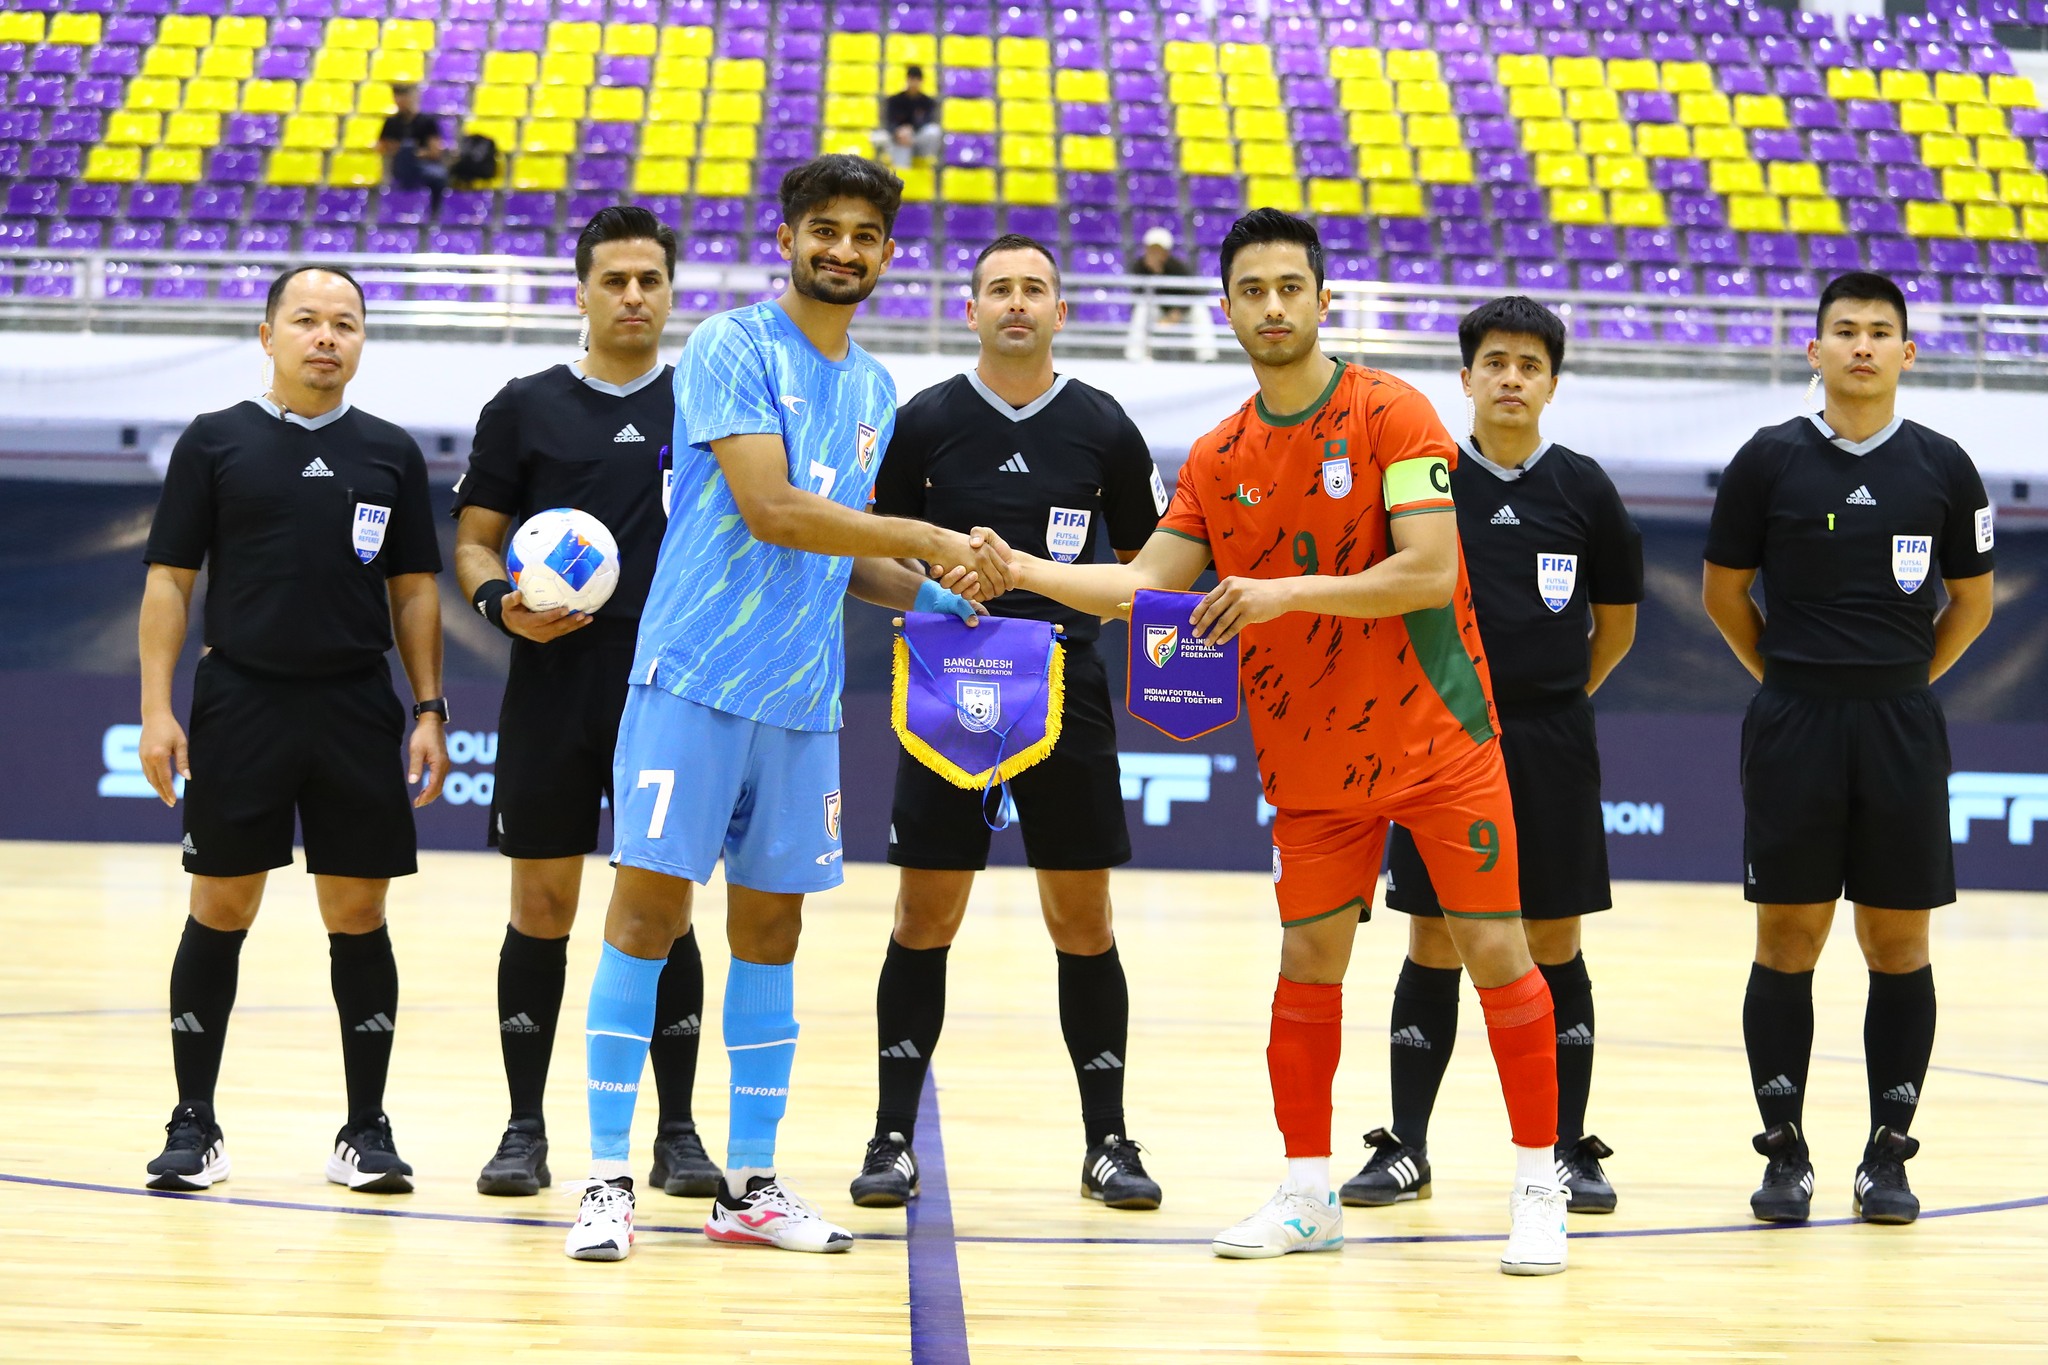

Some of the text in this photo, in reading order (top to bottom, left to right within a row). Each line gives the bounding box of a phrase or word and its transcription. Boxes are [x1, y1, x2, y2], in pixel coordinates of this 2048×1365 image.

[613, 435, 646, 443] adidas
[809, 459, 837, 499] 7
[1429, 462, 1450, 493] C
[1846, 497, 1877, 506] adidas
[358, 507, 386, 525] FIFA
[1053, 511, 1086, 527] FIFA
[1490, 516, 1521, 525] adidas
[360, 528, 380, 537] FUTSAL
[1055, 532, 1080, 540] FUTSAL
[358, 535, 380, 544] REFEREE
[1053, 538, 1080, 547] REFEREE
[1897, 540, 1928, 553] FIFA
[1057, 553, 1073, 562] 2026
[1292, 531, 1320, 576] 9
[1542, 558, 1573, 572] FIFA
[1180, 651, 1224, 659] FEDERATION
[943, 657, 1014, 669] BANGLADESH
[943, 667, 1013, 676] FOOTBALL FEDERATION
[1143, 687, 1206, 697] INDIAN FOOTBALL
[1143, 694, 1223, 704] FORWARD TOGETHER
[445, 730, 499, 765] OU
[636, 769, 675, 839] 7
[1601, 801, 1664, 836] ION
[1467, 819, 1500, 872] 9
[661, 1027, 701, 1036] adida
[1757, 1086, 1798, 1097] adidas
